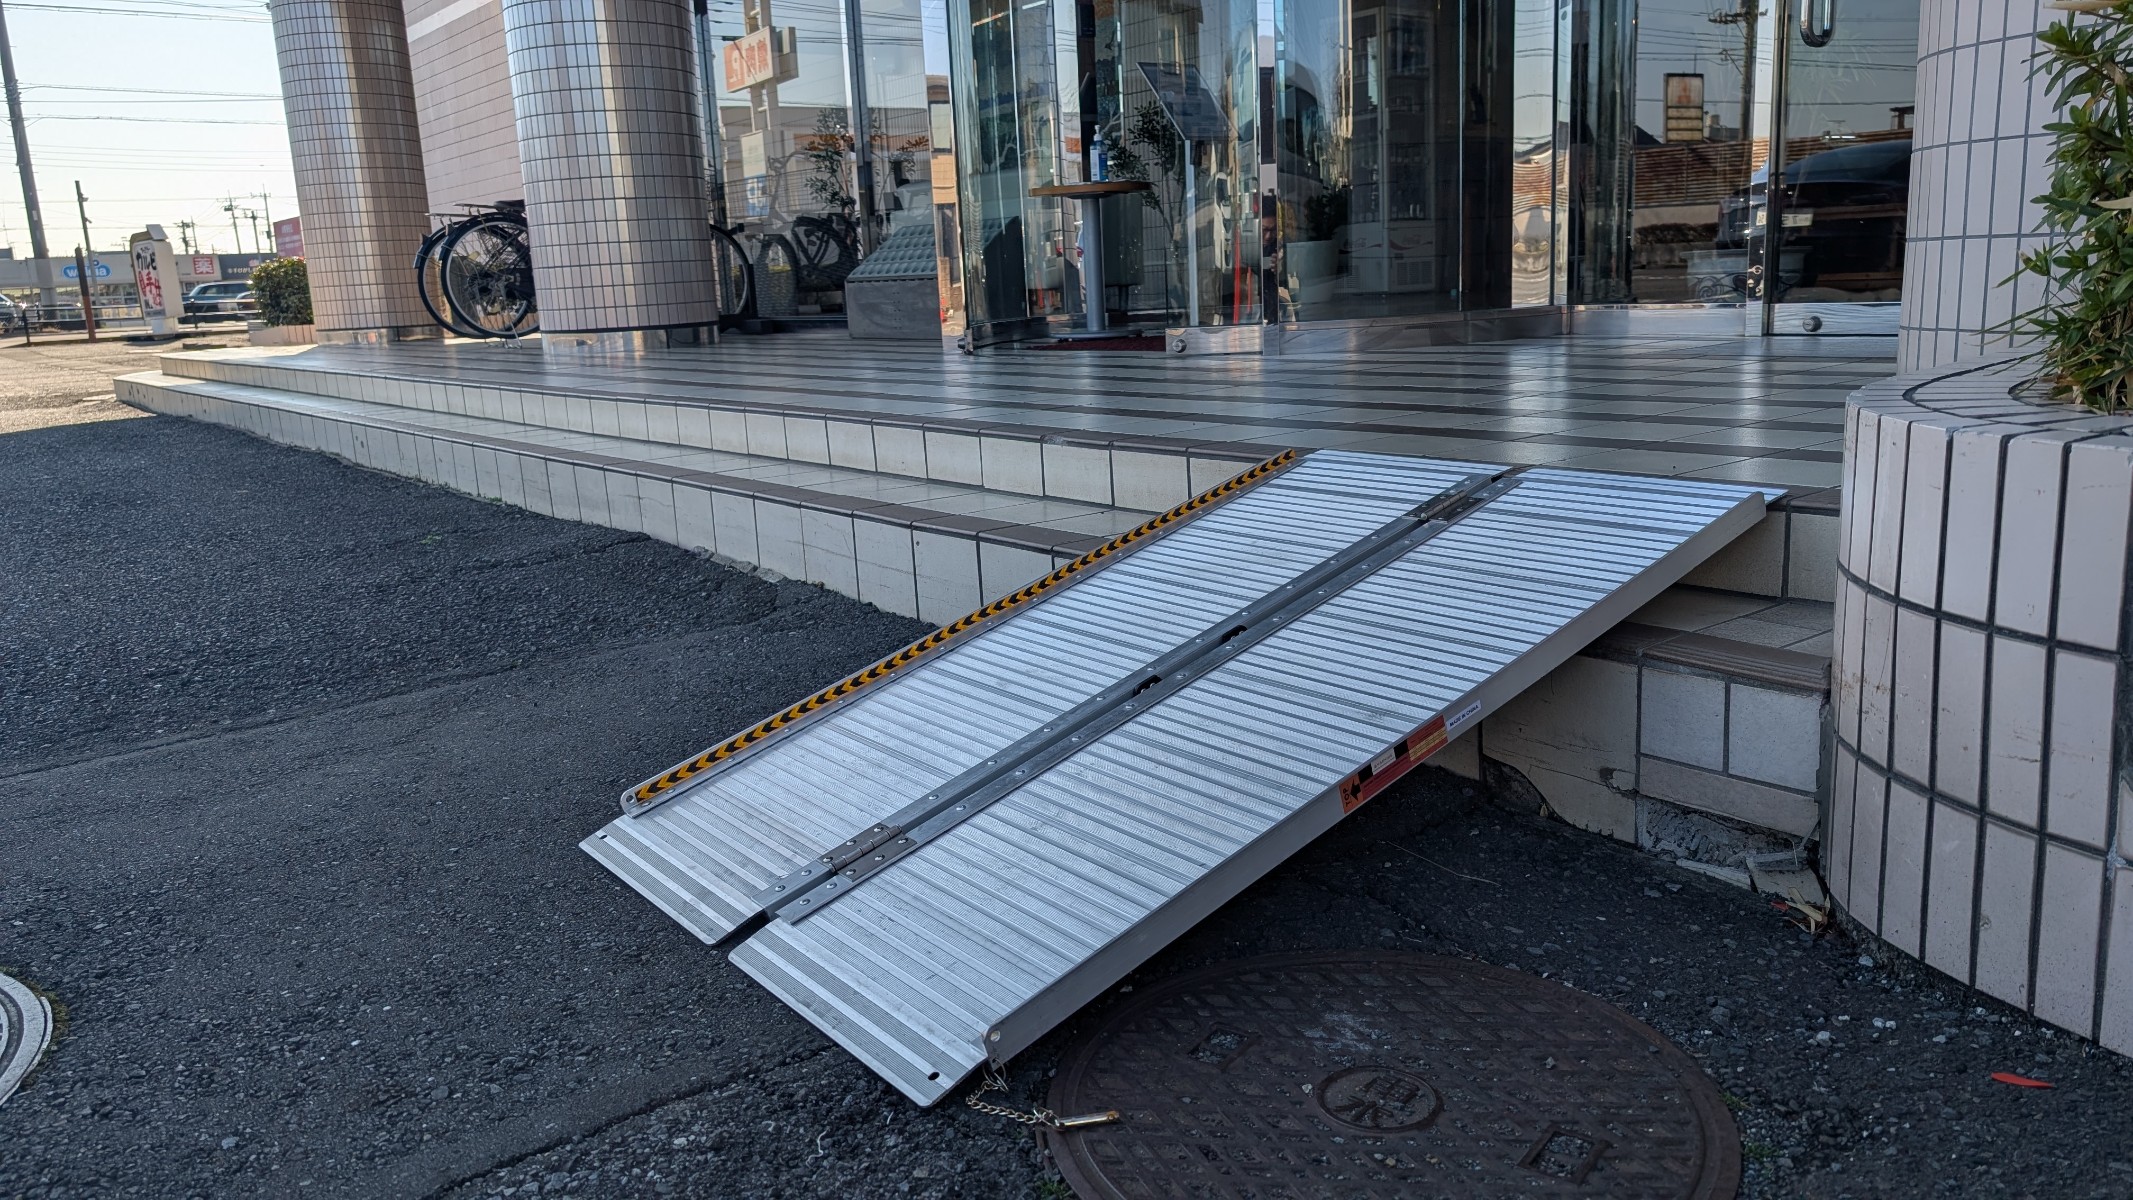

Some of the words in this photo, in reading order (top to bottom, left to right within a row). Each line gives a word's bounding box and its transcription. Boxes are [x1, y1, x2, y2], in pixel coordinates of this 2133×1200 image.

[1450, 716, 1461, 727] MADE
[1467, 704, 1479, 715] CHINA
[1343, 788, 1352, 807] TOP
